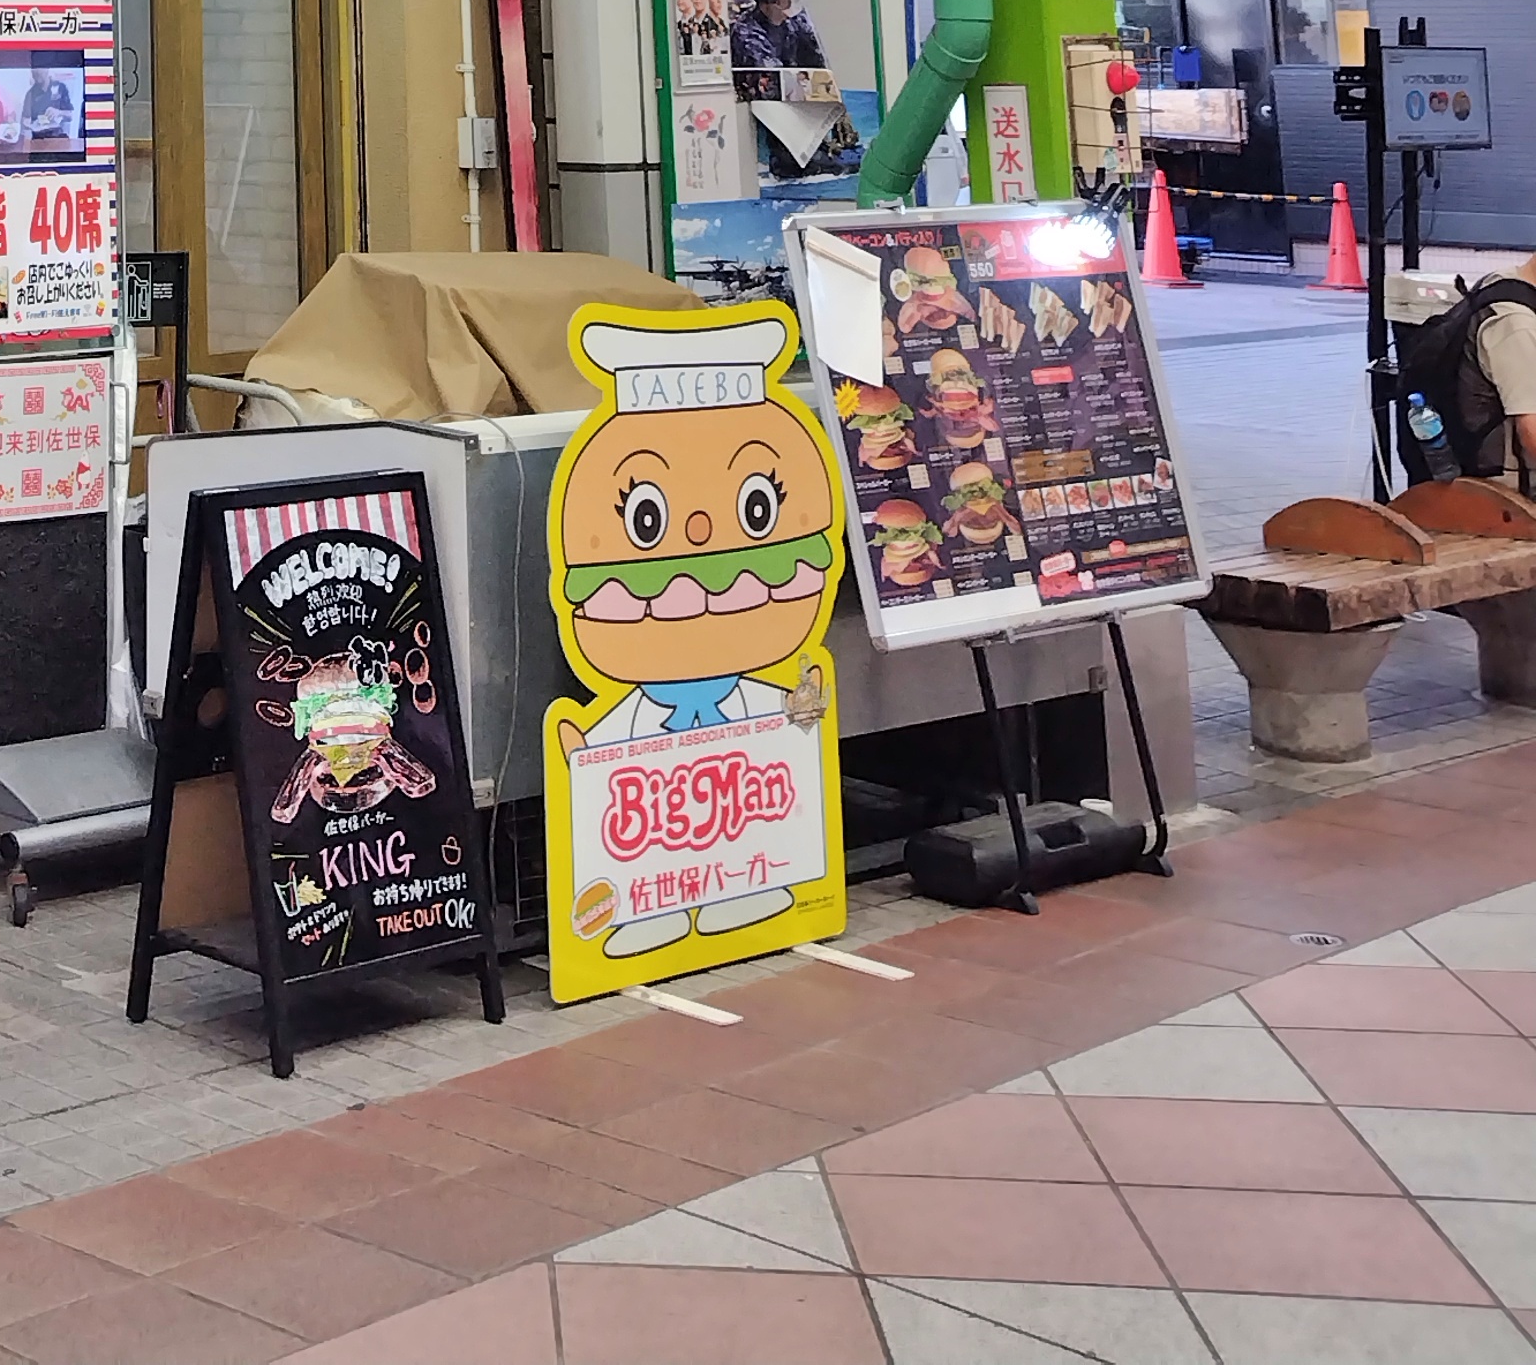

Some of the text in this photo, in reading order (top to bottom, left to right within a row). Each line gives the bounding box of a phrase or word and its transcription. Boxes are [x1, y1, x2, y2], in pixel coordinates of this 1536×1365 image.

[29, 181, 103, 255] 40席
[967, 261, 995, 279] 550
[630, 371, 755, 408] SASEBO
[261, 541, 401, 609] WELCOME!
[577, 717, 784, 767] SASEBO BURGER ASSOCIATION SHOP
[318, 830, 416, 892] KING
[629, 851, 791, 915] 佐世保バーガー
[376, 898, 477, 938] TAKE OUT OK!
